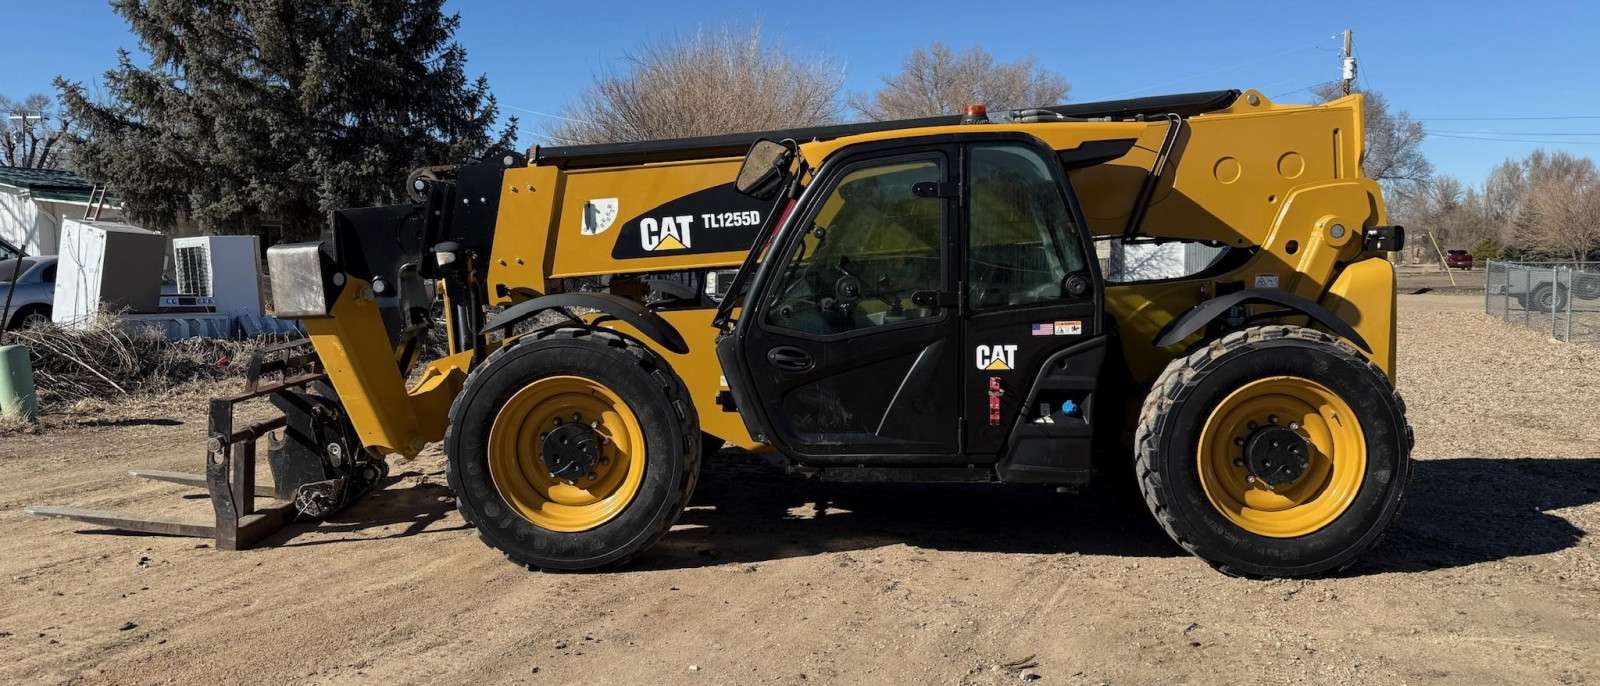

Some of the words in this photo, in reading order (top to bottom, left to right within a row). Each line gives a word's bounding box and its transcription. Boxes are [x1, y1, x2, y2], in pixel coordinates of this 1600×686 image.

[640, 215, 693, 251] CAT
[702, 210, 760, 228] TL1255D
[976, 345, 1018, 370] CAT
